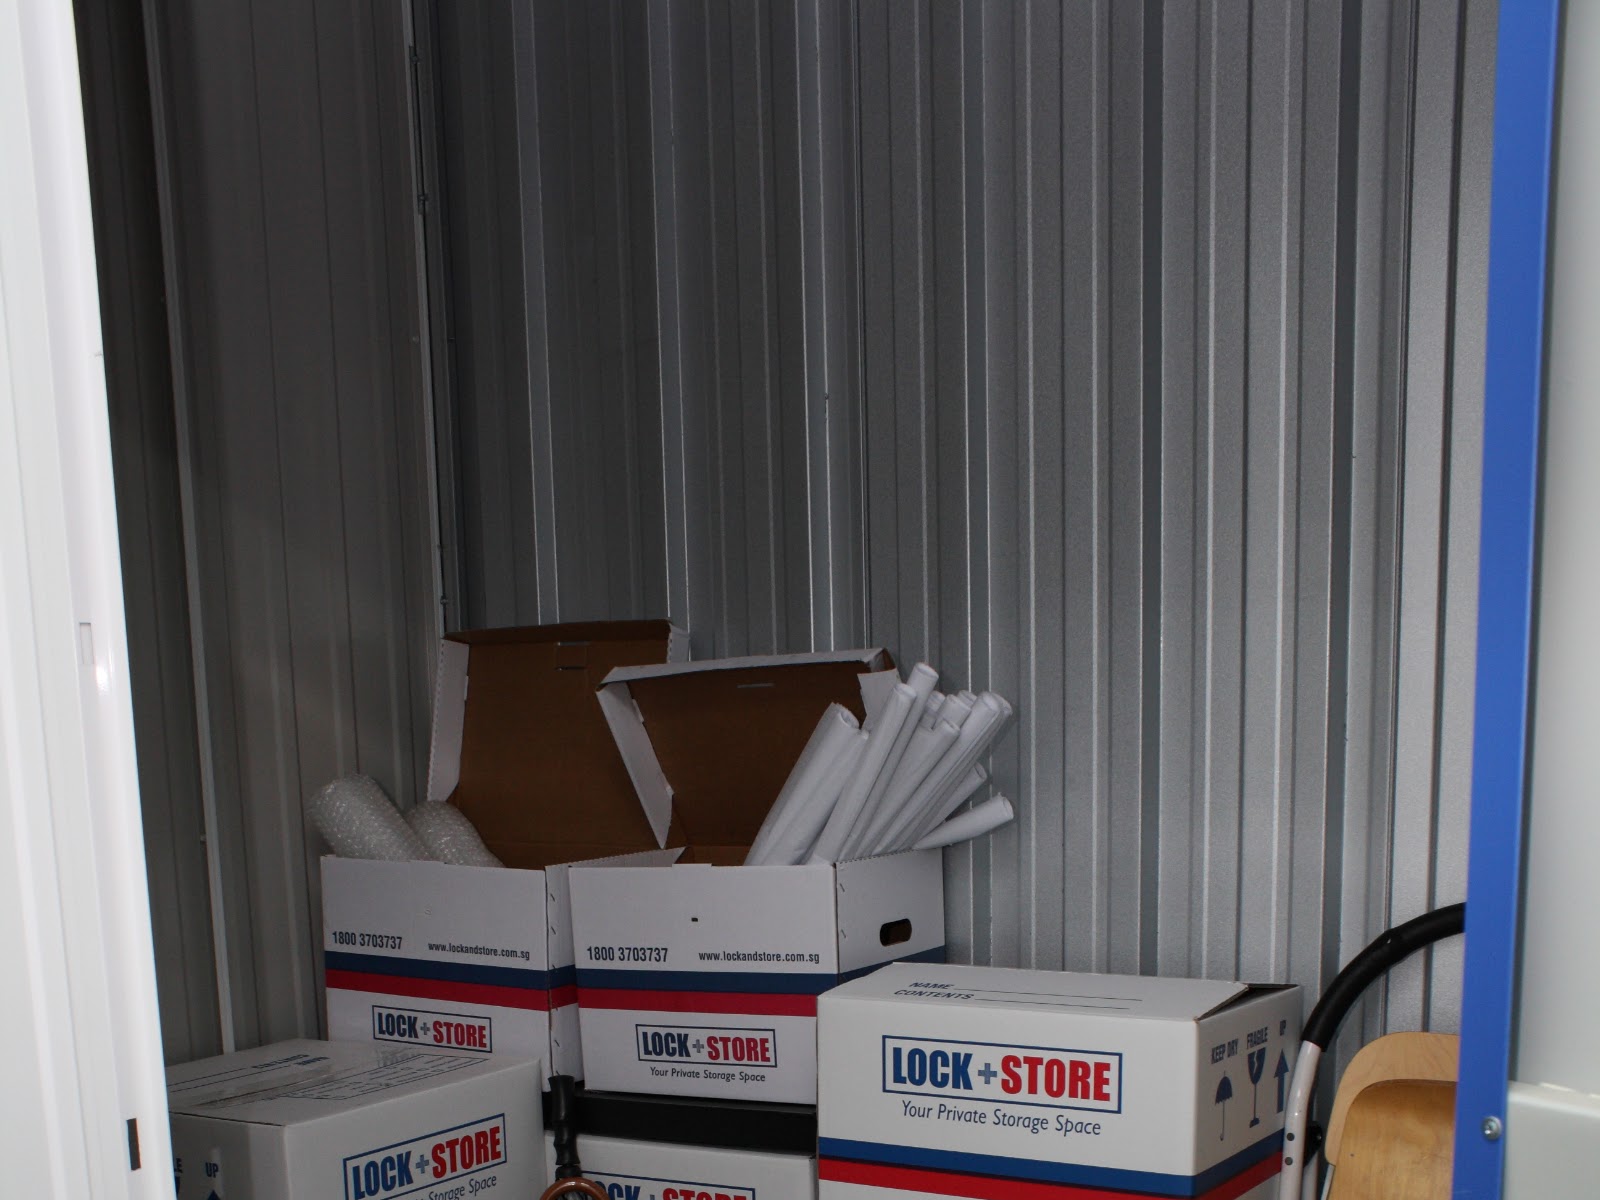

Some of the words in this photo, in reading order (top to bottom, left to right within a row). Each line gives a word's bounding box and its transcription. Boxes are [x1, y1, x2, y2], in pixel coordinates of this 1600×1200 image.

[332, 931, 356, 946] 1800
[359, 933, 403, 950] 3703737
[428, 942, 530, 961] www.lockandstore.com.sg
[587, 946, 615, 961] 1800
[618, 947, 668, 963] 3703737
[698, 951, 820, 965] www.lockandstore.com.sg
[894, 989, 975, 999] CONTENTS
[650, 1067, 669, 1078] Your
[671, 1068, 700, 1079] Private
[703, 1069, 736, 1083] Storage
[739, 1071, 766, 1083] Space
[902, 1100, 933, 1119] Your
[937, 1103, 987, 1124] Private
[993, 1108, 1049, 1134] Storage
[1055, 1114, 1101, 1137] Space
[205, 1162, 219, 1178] UP
[468, 1175, 497, 1196] Space
